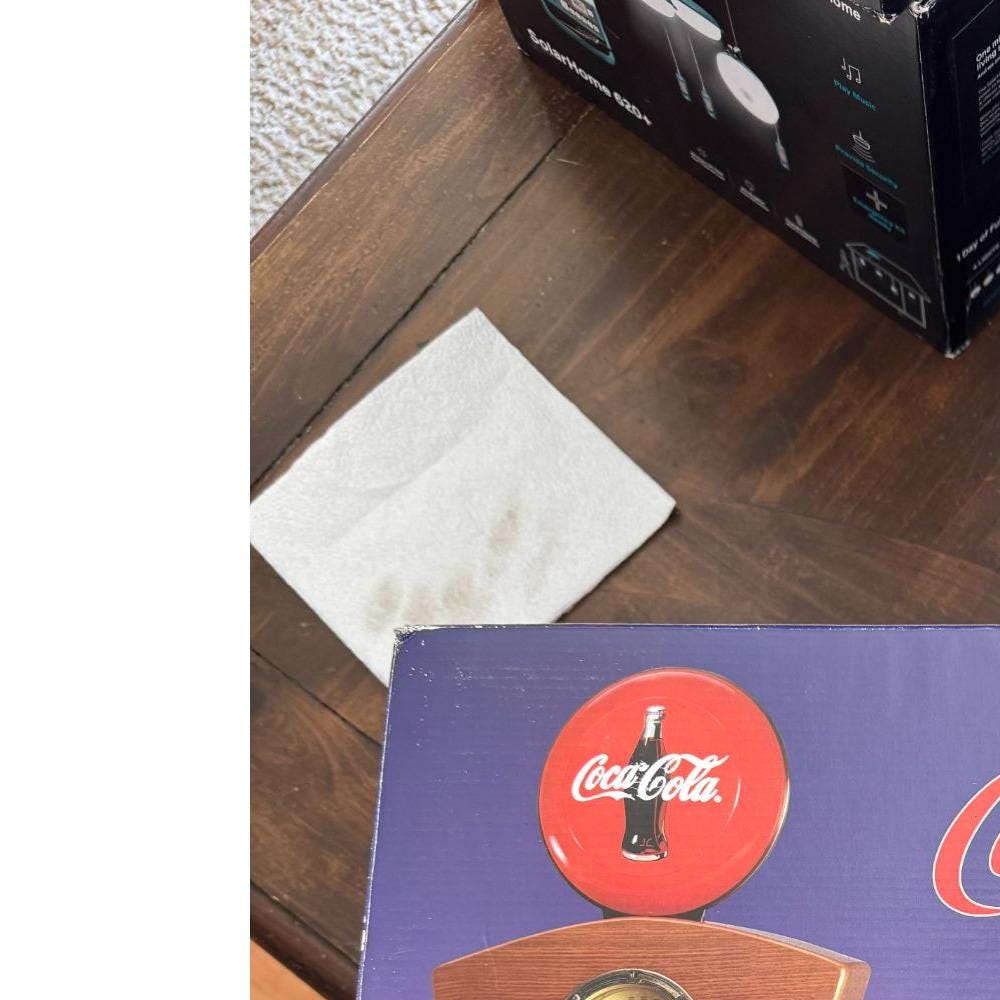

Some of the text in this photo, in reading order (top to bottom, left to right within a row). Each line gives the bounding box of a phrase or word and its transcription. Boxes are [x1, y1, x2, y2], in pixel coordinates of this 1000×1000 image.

[829, 0, 861, 20] ome
[976, 46, 990, 62] One
[976, 49, 996, 71] living
[527, 28, 652, 126] SolarHome 620+
[962, 240, 979, 259] Day
